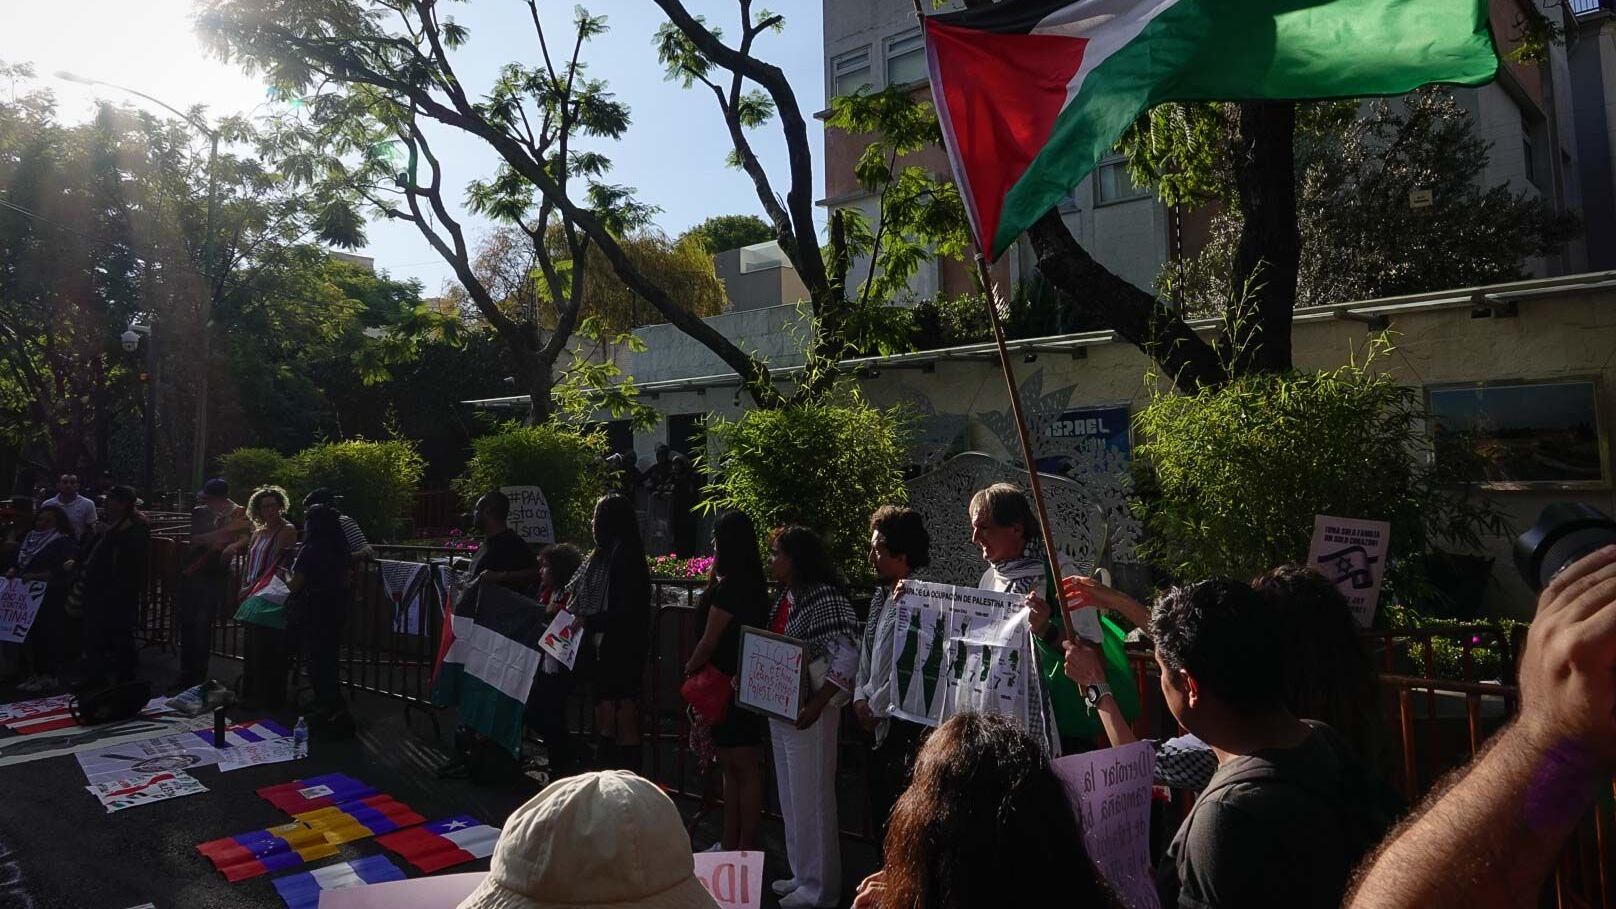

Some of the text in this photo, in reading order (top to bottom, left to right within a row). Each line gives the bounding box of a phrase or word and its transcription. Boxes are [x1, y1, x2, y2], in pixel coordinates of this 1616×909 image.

[931, 590, 962, 602] OCUPACÓN
[963, 595, 972, 603] DE
[972, 596, 1005, 608] PALESTINA
